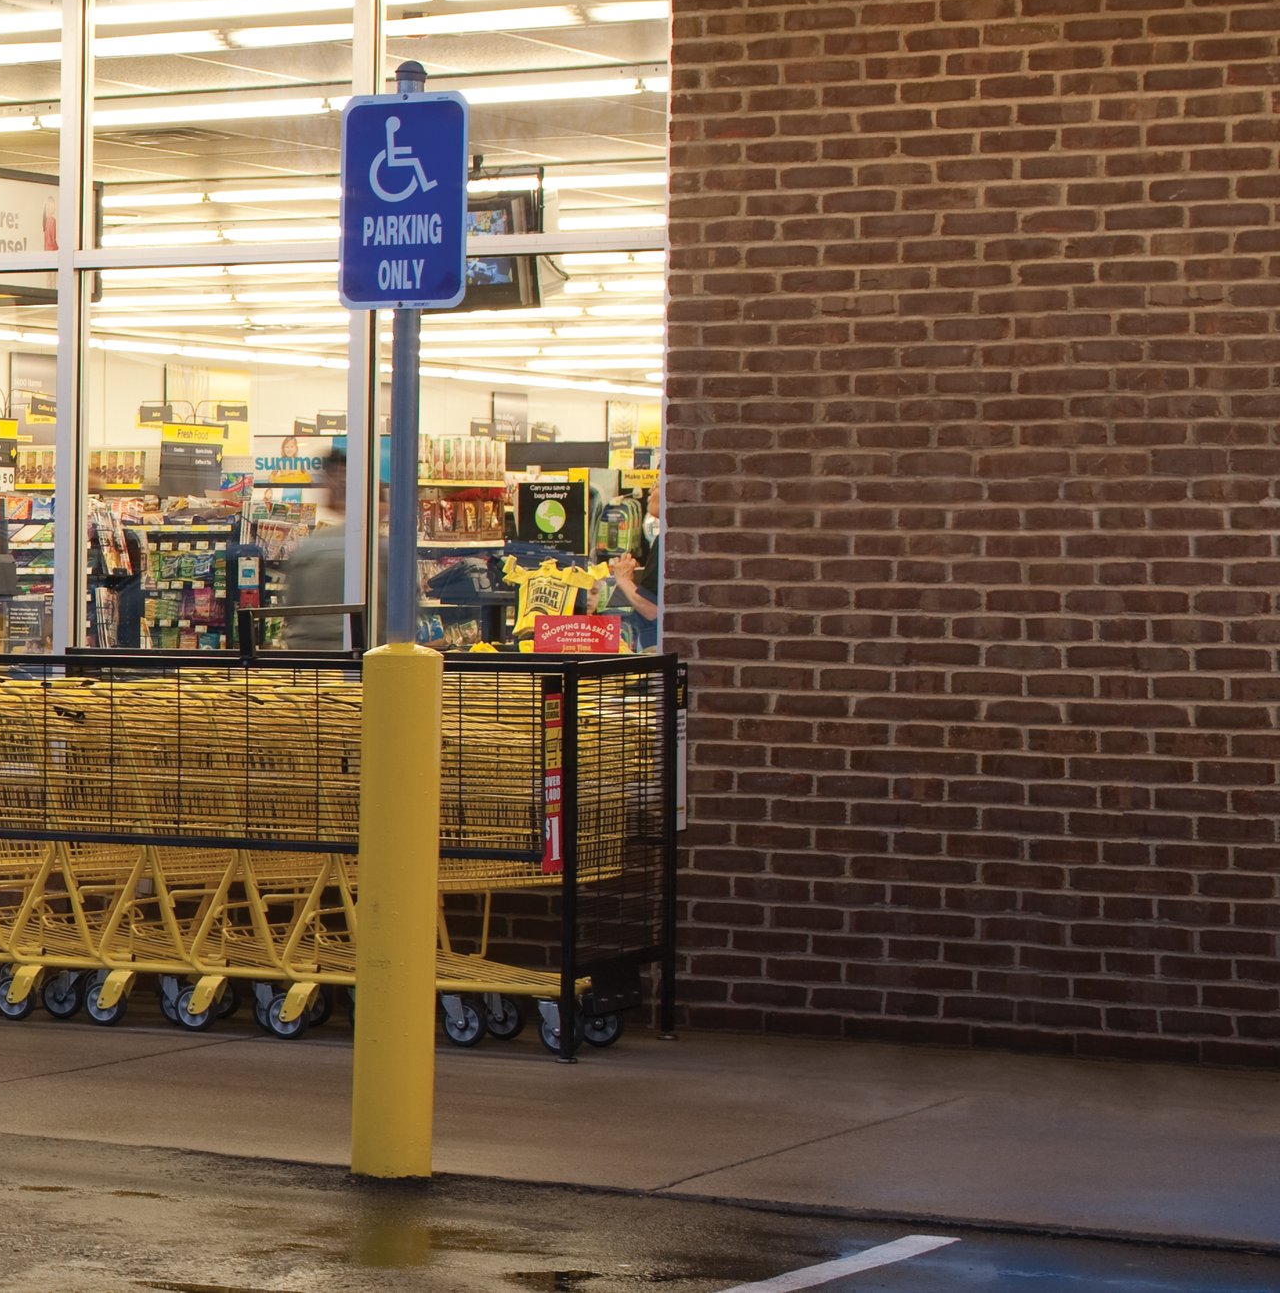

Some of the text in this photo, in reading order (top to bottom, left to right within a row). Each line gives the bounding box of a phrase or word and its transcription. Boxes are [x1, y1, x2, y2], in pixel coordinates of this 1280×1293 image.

[363, 213, 442, 246] PARKING
[378, 259, 424, 290] ONLY
[177, 428, 209, 440] Fresh Food
[255, 456, 320, 471] summe
[534, 492, 568, 500] bag today?
[541, 623, 614, 641] SHOPPING BASKETS
[545, 775, 560, 788] OVER
